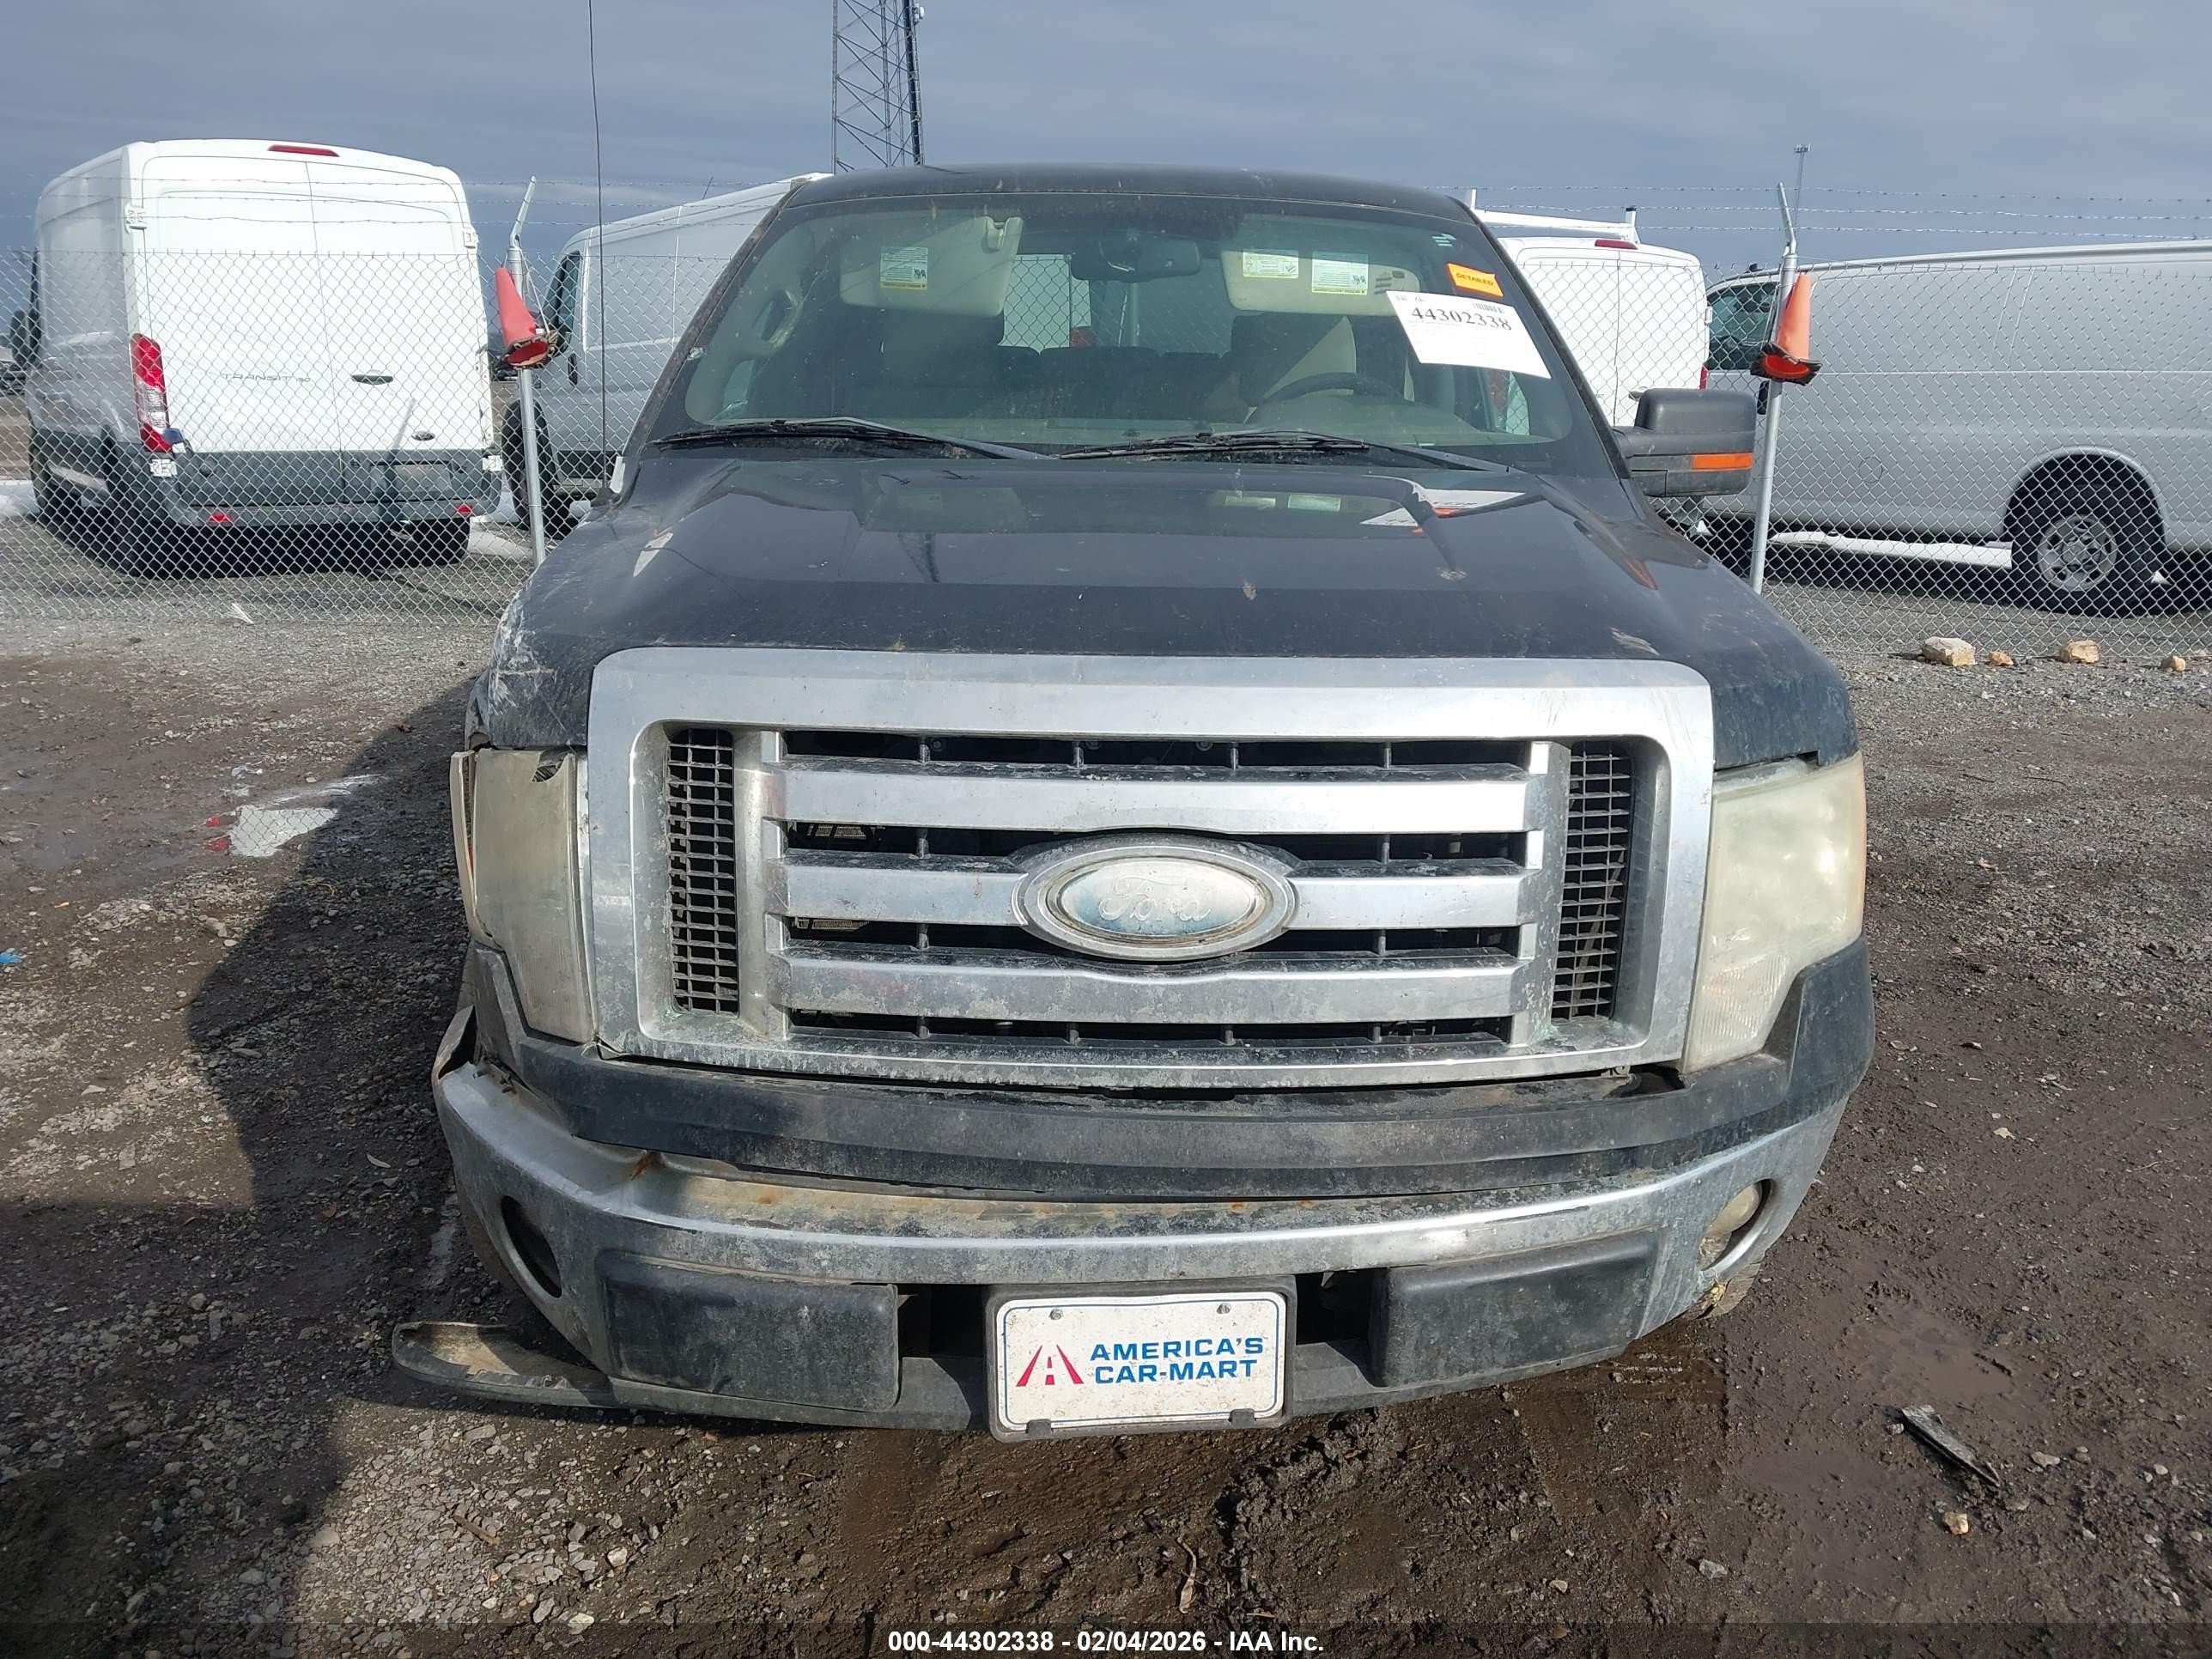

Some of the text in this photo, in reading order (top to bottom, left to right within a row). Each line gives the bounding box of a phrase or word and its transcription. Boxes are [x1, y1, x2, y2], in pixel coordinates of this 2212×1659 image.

[1411, 307, 1512, 331] 44302338
[1090, 1337, 1264, 1361] AMERICA'S
[1095, 1359, 1258, 1384] CAR-MART
